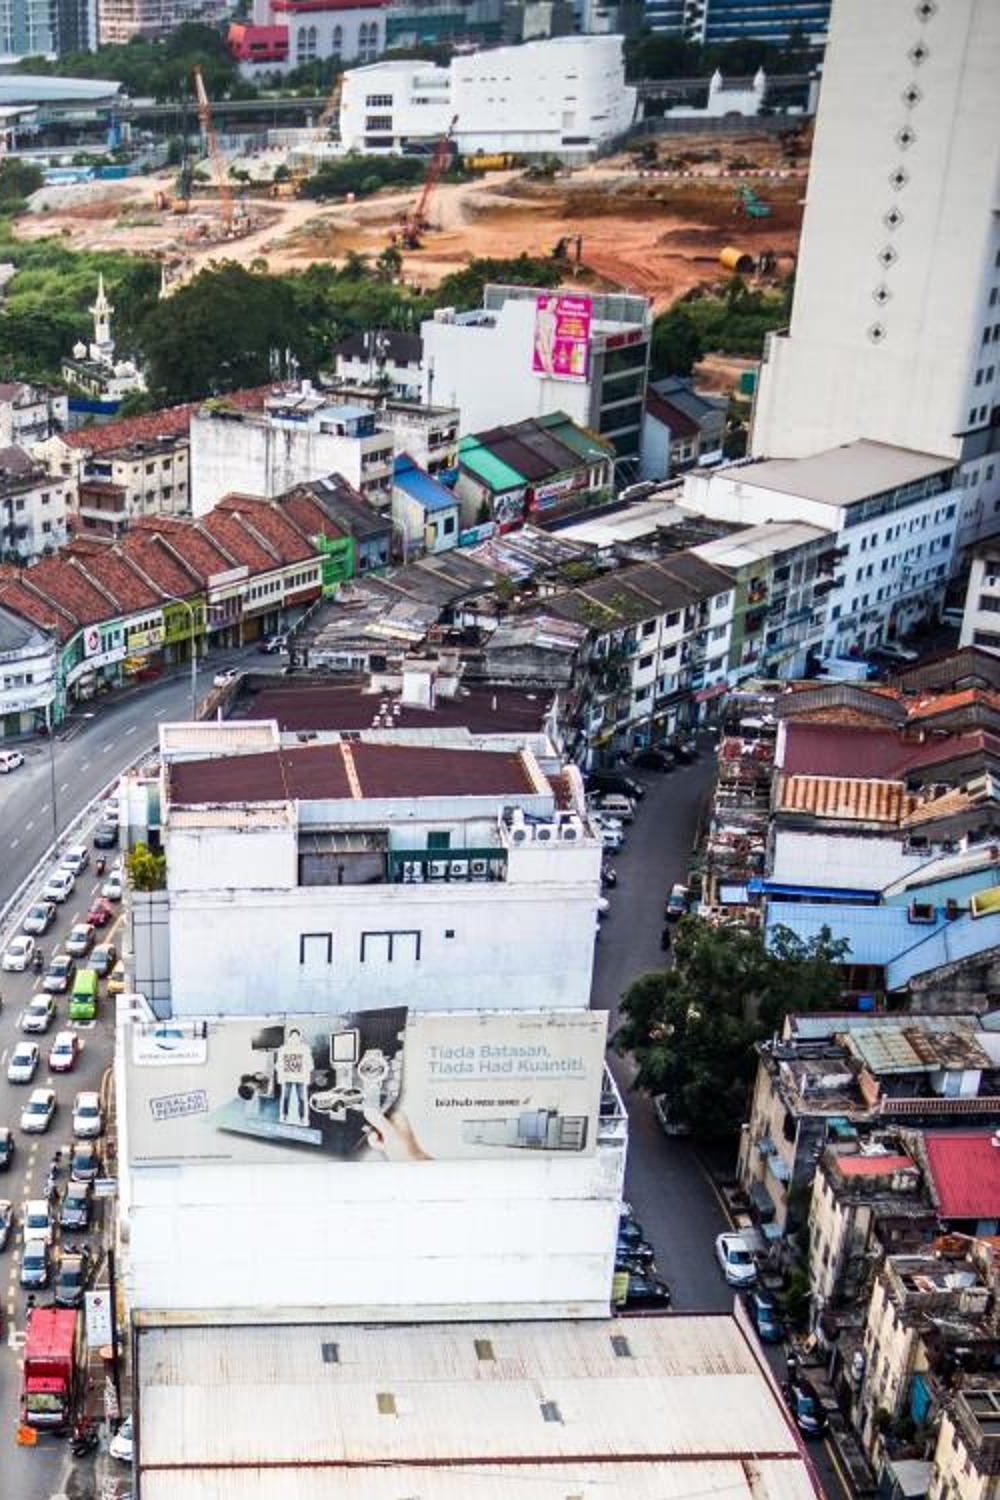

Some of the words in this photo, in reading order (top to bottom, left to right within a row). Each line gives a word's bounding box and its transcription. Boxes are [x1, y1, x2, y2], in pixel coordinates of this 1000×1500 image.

[429, 1045, 475, 1058] Tiada
[480, 1044, 551, 1059] Batasan,
[429, 1061, 474, 1073] Tiada
[480, 1059, 512, 1073] Had
